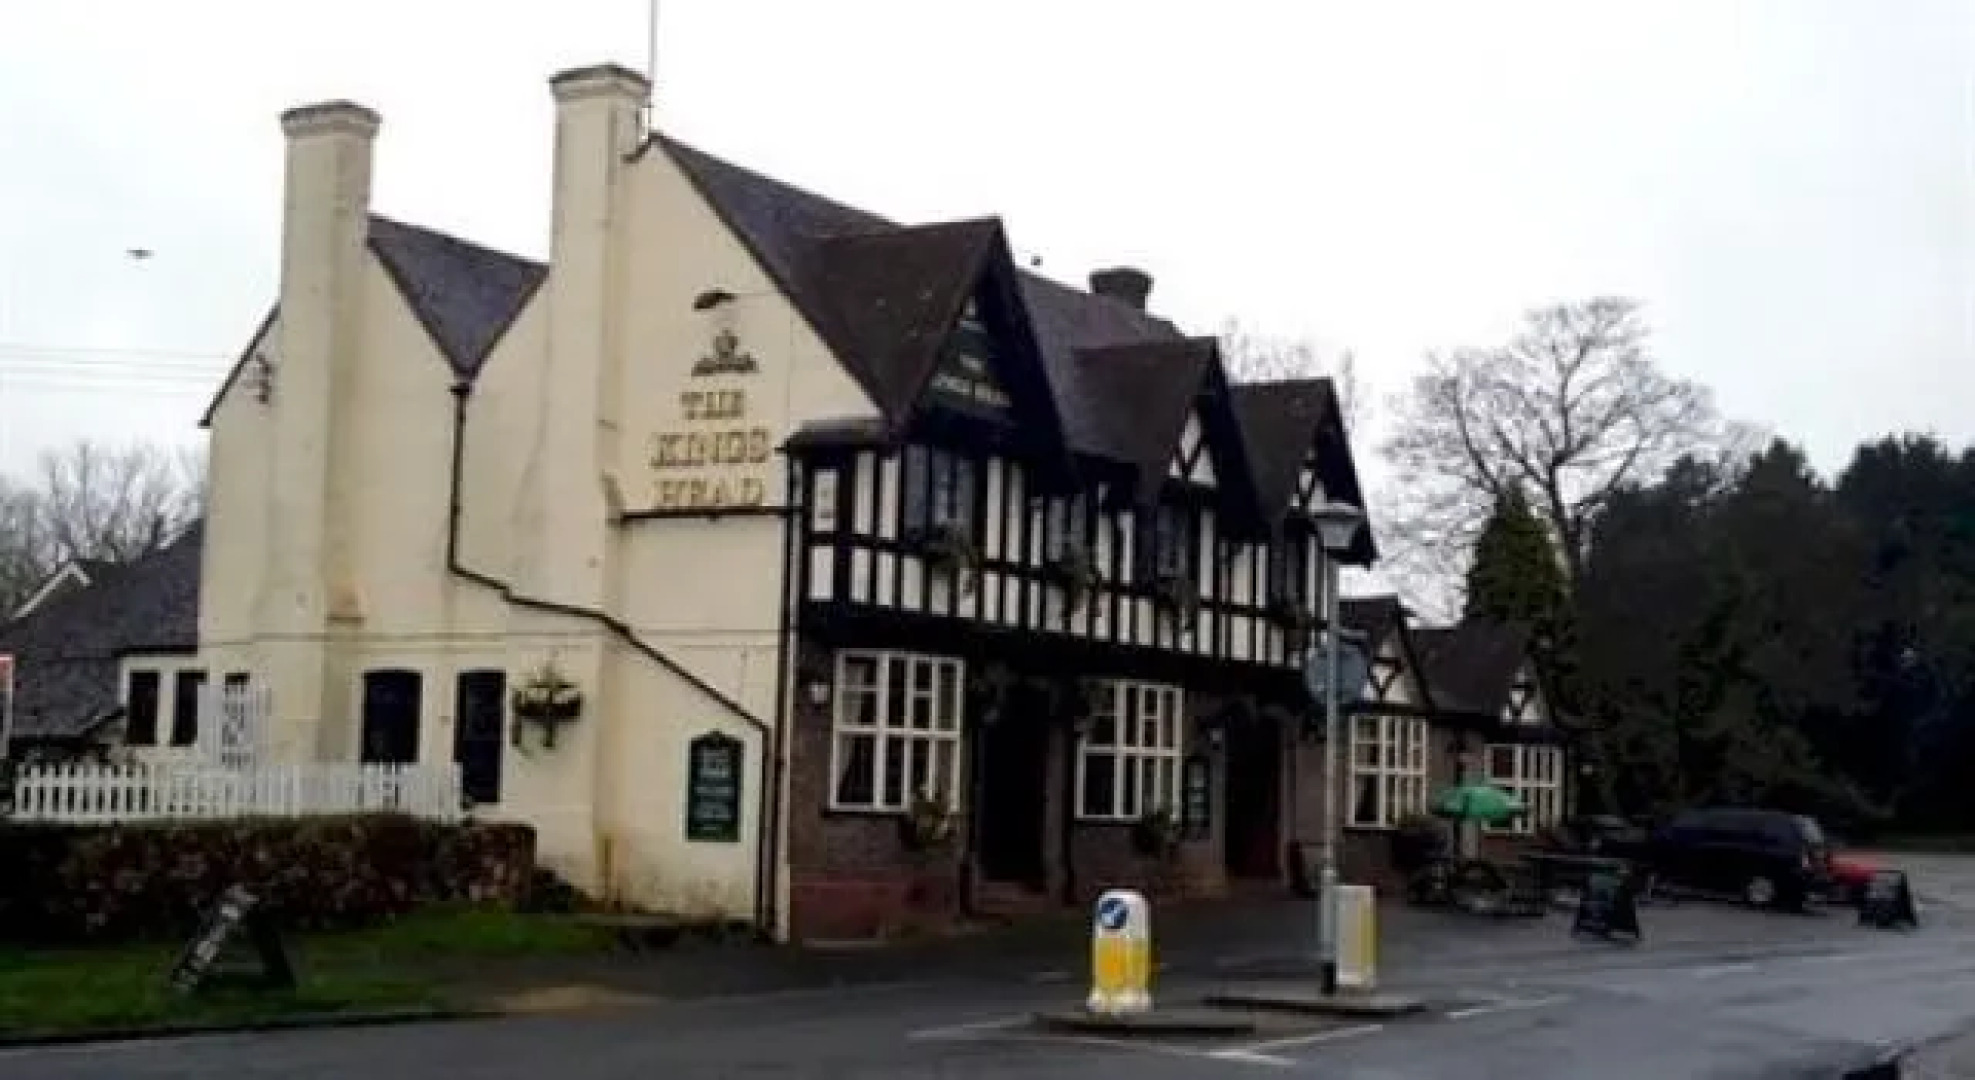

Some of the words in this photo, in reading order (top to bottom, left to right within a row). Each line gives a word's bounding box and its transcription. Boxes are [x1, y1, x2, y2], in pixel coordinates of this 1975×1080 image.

[680, 391, 745, 421] THE
[651, 427, 769, 467] KINGS
[654, 477, 764, 508] HEAD
